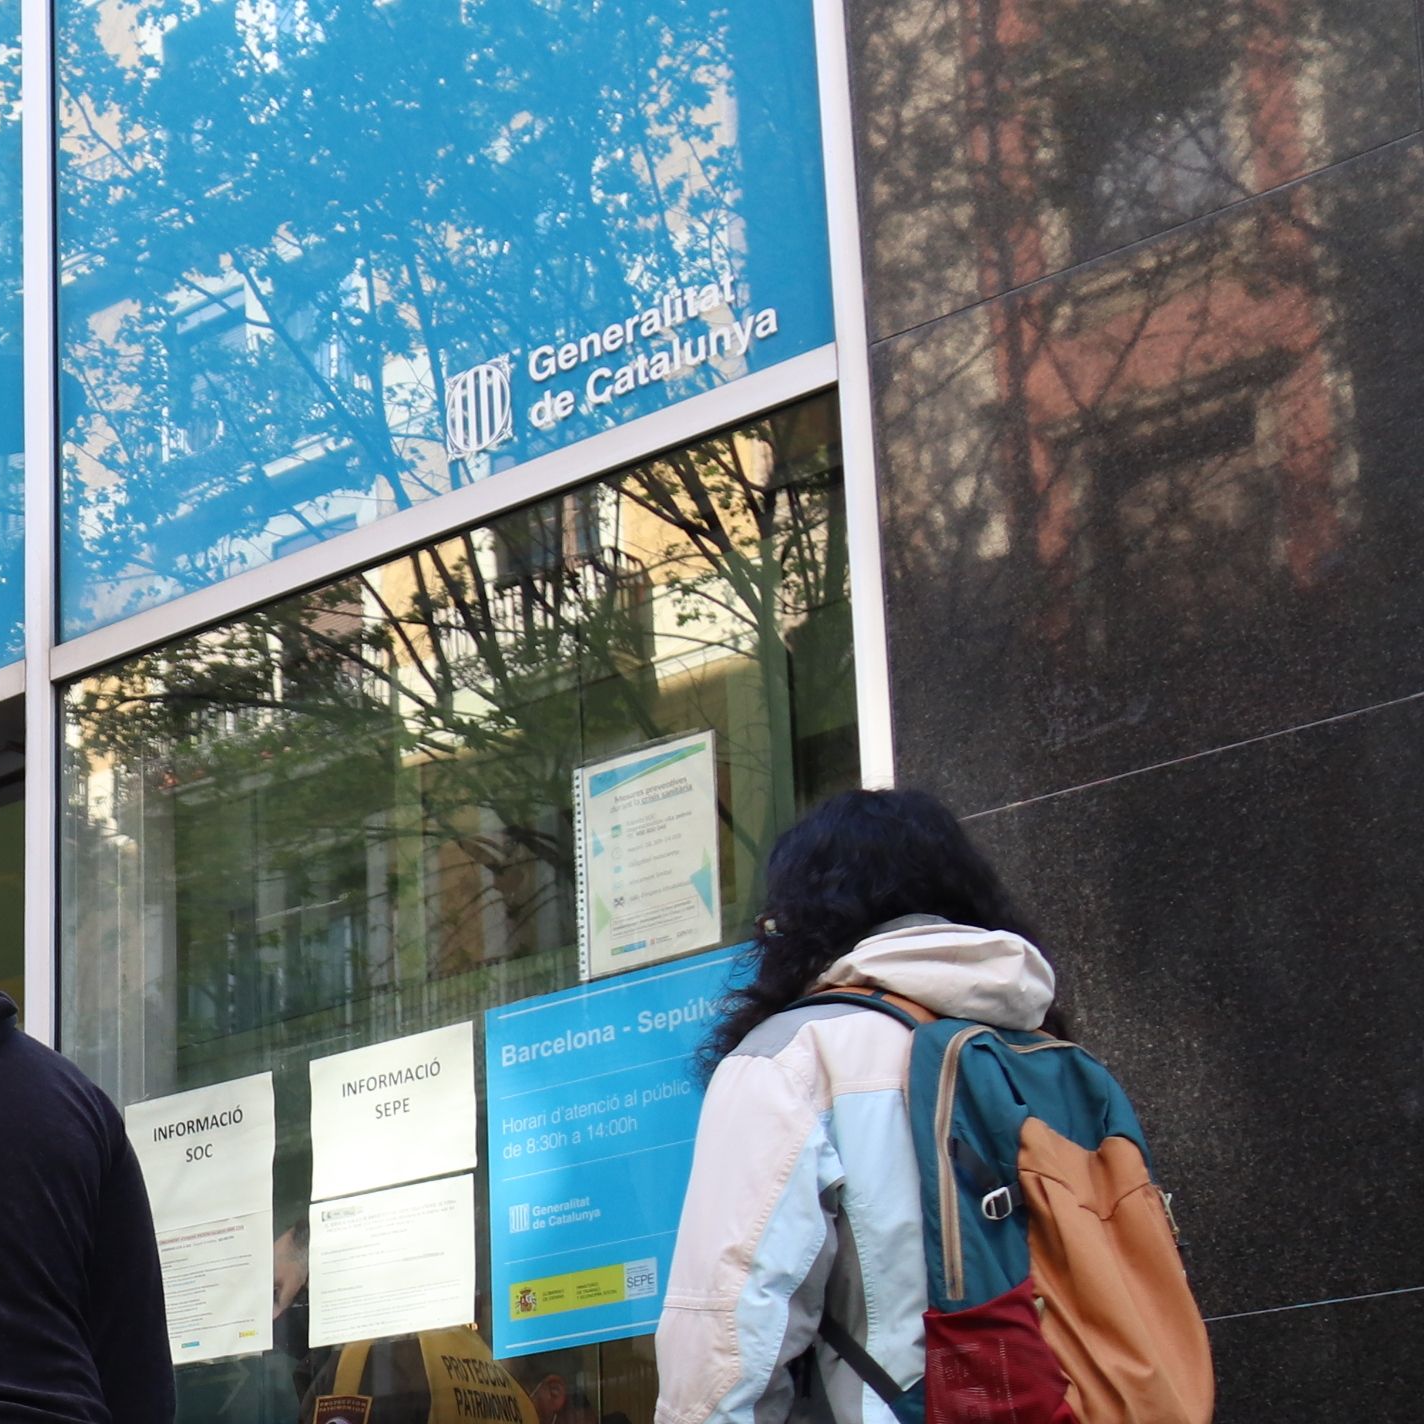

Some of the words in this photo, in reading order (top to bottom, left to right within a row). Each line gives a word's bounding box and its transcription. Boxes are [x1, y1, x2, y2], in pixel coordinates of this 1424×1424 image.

[528, 273, 736, 382] Generalitat
[530, 388, 576, 429] de
[585, 306, 780, 405] Catalunya
[501, 1023, 616, 1068] Barcelona
[637, 996, 722, 1035] Sepúlv
[342, 1056, 442, 1098] INFORMACIÓ
[153, 1104, 244, 1142] INFORMACIÓ
[374, 1097, 411, 1120] SEPE
[502, 1112, 546, 1135] Horari
[551, 1096, 620, 1124] d'atenció
[624, 1091, 638, 1108] al
[642, 1079, 691, 1108] públic
[185, 1143, 213, 1163] SOC
[502, 1141, 522, 1160] de
[526, 1131, 568, 1153] 8:30h
[572, 1130, 582, 1144] a
[587, 1115, 639, 1140] 14:00h
[532, 1196, 590, 1217] Generalitat
[532, 1217, 546, 1230] de
[548, 1208, 601, 1228] Catalunya
[626, 1272, 655, 1289] SEPE
